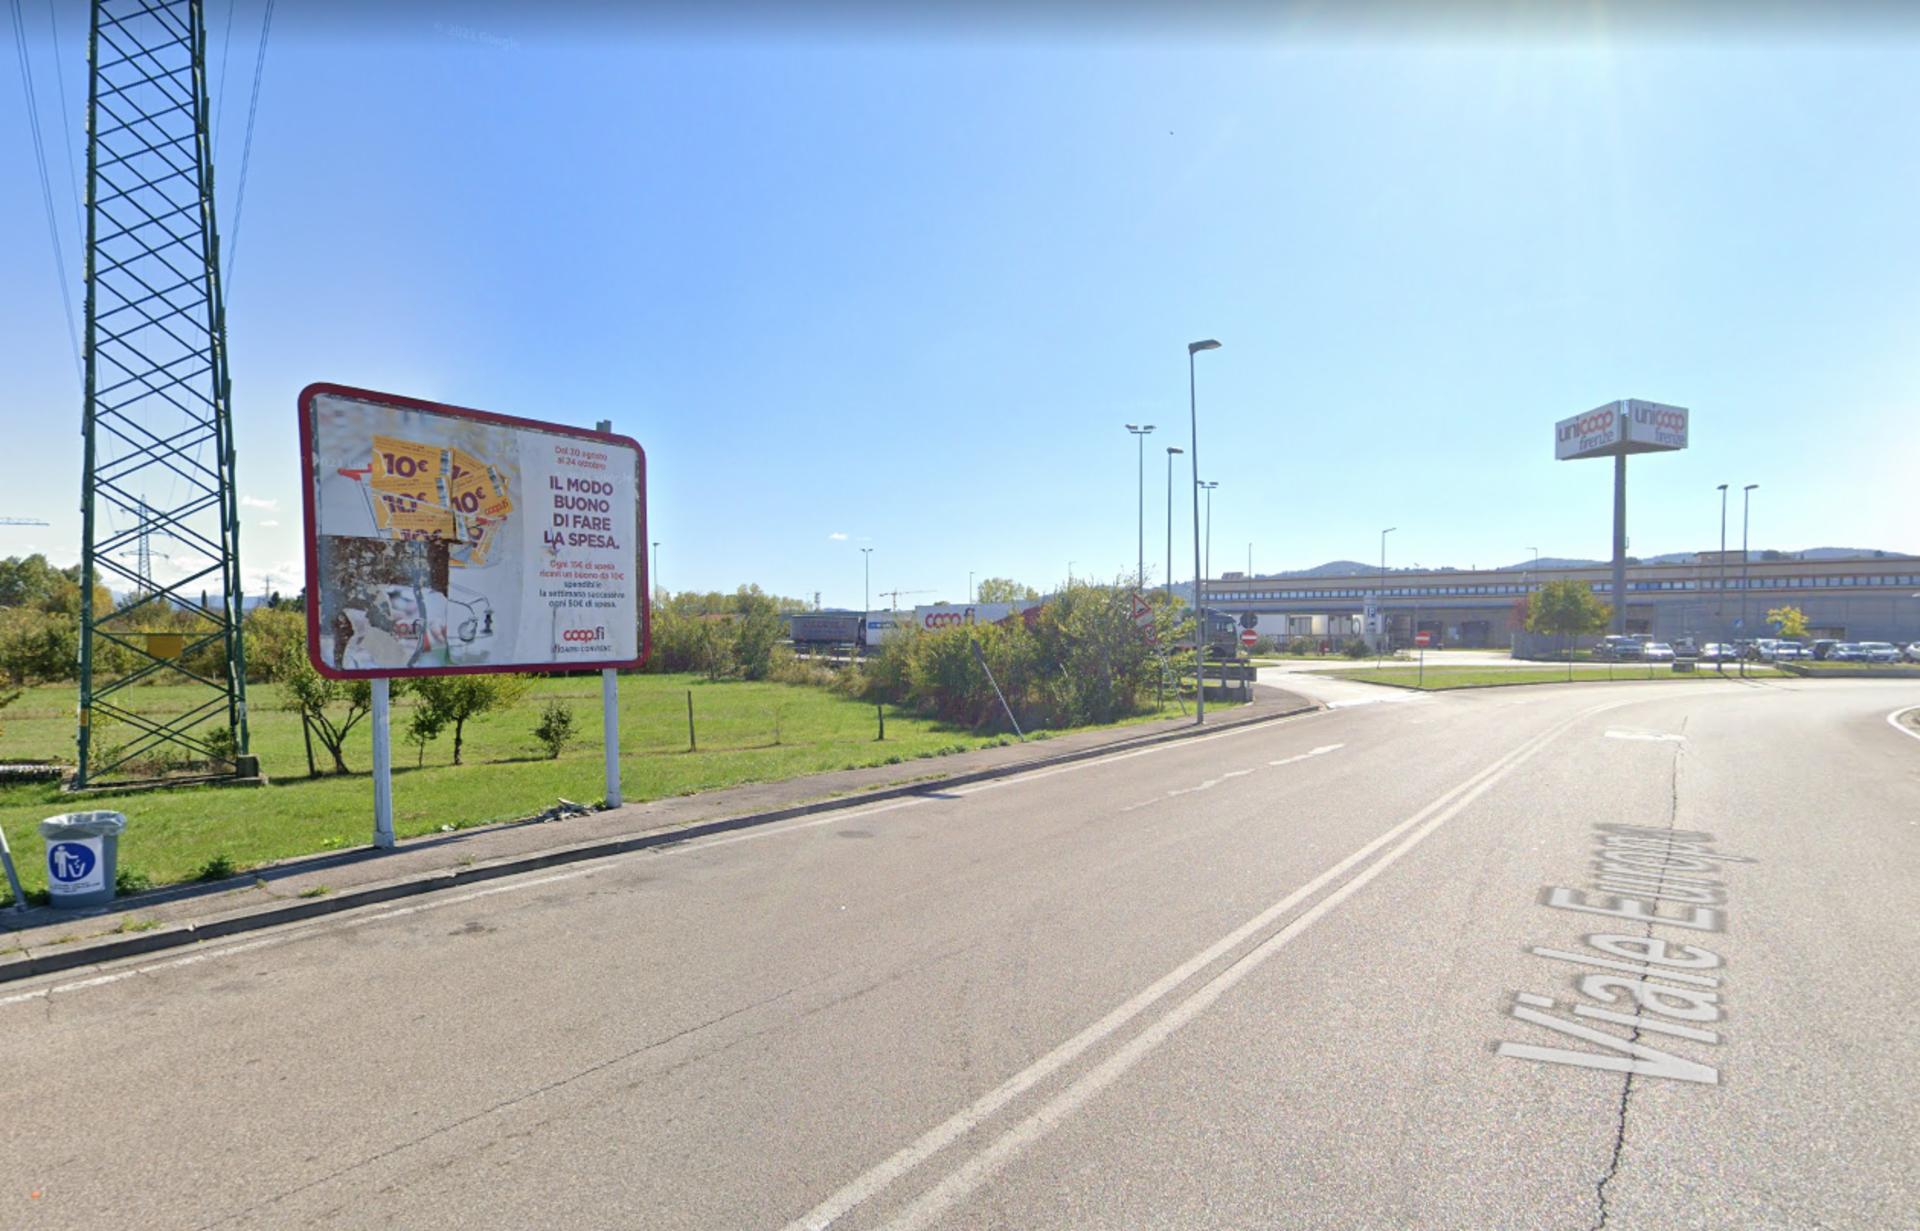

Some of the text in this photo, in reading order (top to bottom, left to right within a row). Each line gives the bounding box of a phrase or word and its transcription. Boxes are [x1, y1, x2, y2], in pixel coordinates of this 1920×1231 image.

[1559, 411, 1613, 442] unicoop
[1635, 403, 1685, 432] unicoop
[383, 453, 428, 478] 10€
[565, 457, 576, 465] 24
[550, 475, 614, 496] IL MODO
[554, 494, 610, 513] BUONO
[553, 512, 611, 531] DI FARE
[543, 530, 620, 549] LA SPESA.
[574, 571, 599, 579] buono
[585, 561, 593, 570] di
[548, 600, 566, 609] ogni
[925, 607, 976, 628] coopfi
[563, 626, 605, 643] coop.fi
